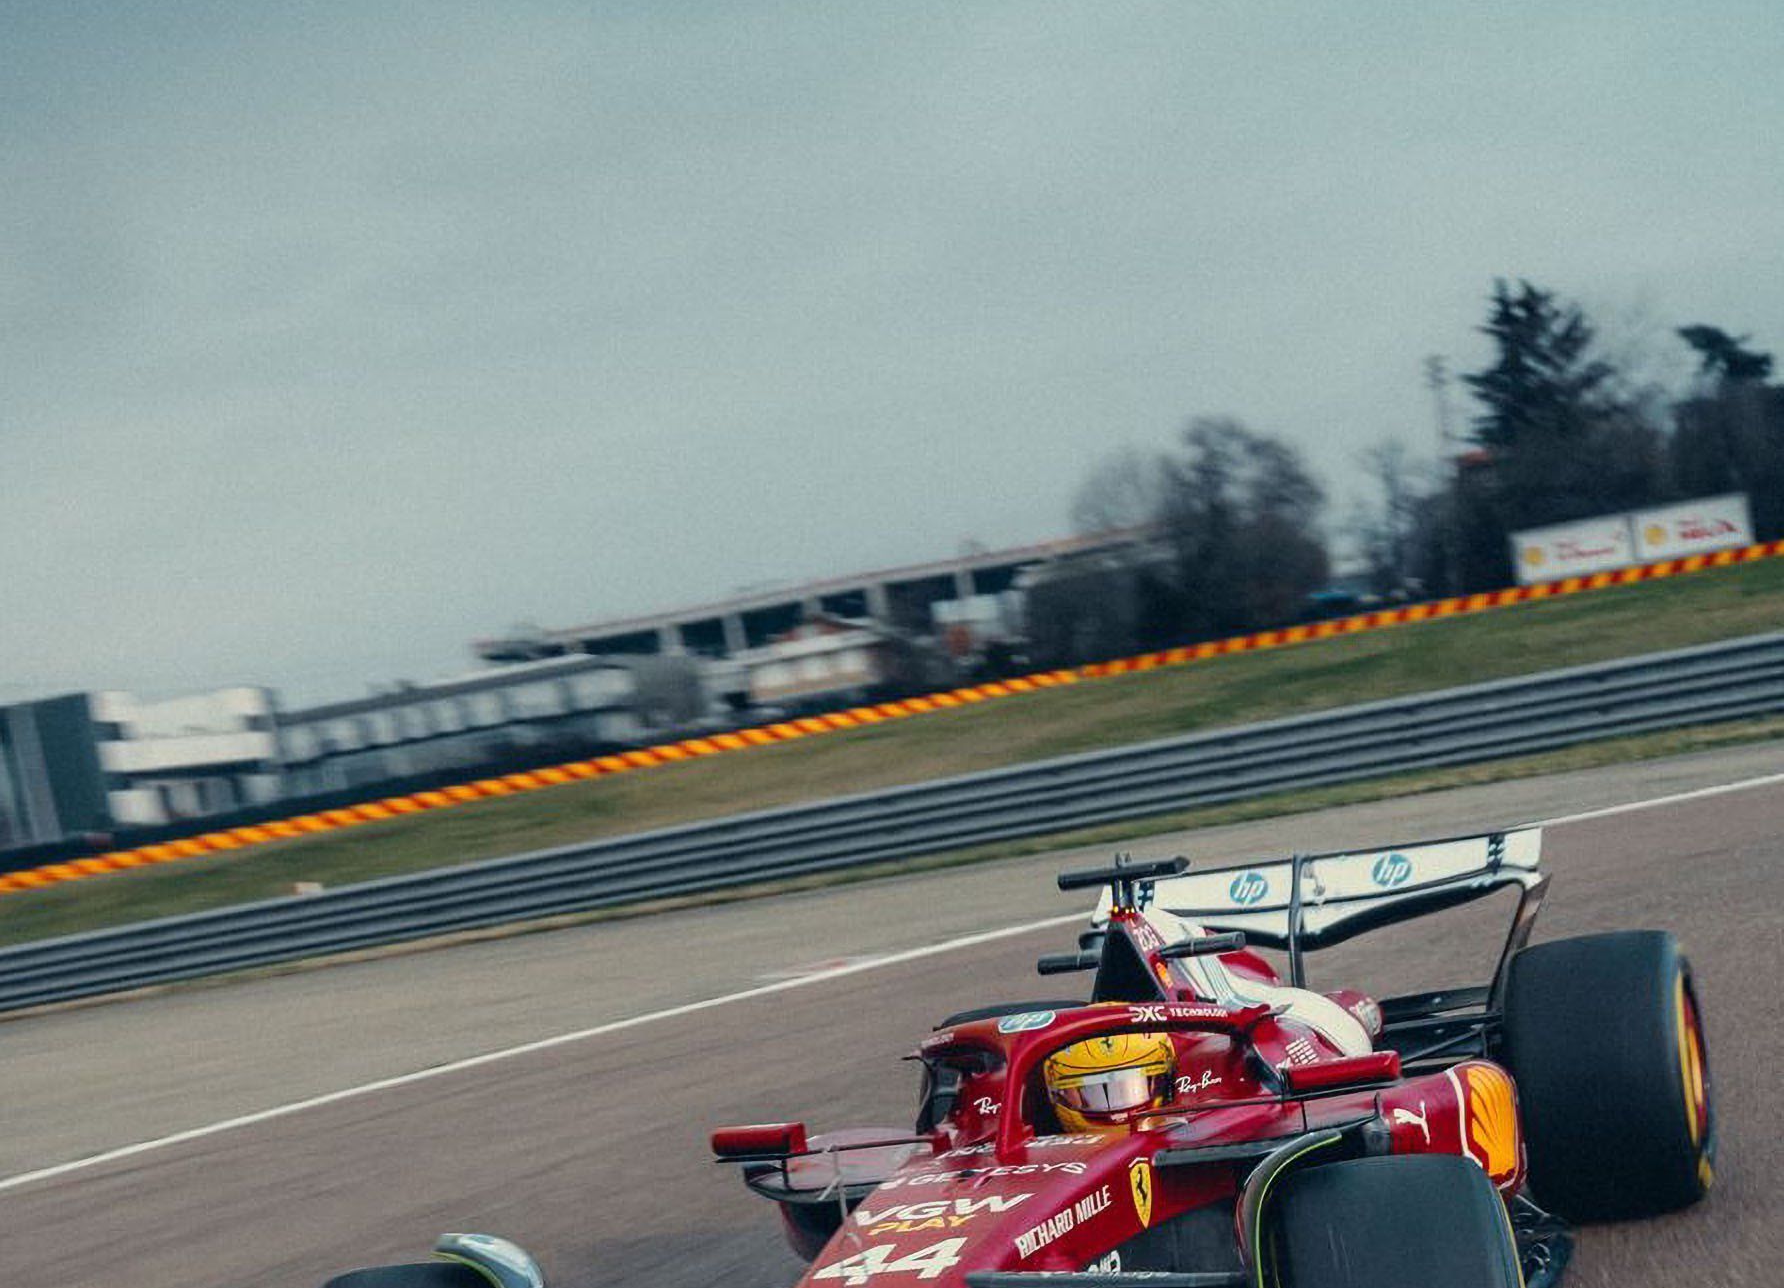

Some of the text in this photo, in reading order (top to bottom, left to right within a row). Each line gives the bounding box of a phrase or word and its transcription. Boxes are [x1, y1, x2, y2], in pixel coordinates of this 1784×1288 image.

[1373, 852, 1412, 887] hp
[1231, 871, 1268, 905] hp
[1174, 1068, 1222, 1094] Ray-Ban
[853, 1192, 1038, 1227] VGW
[1014, 1184, 1113, 1261] RICHARD MILLE
[812, 1236, 969, 1287] 44
